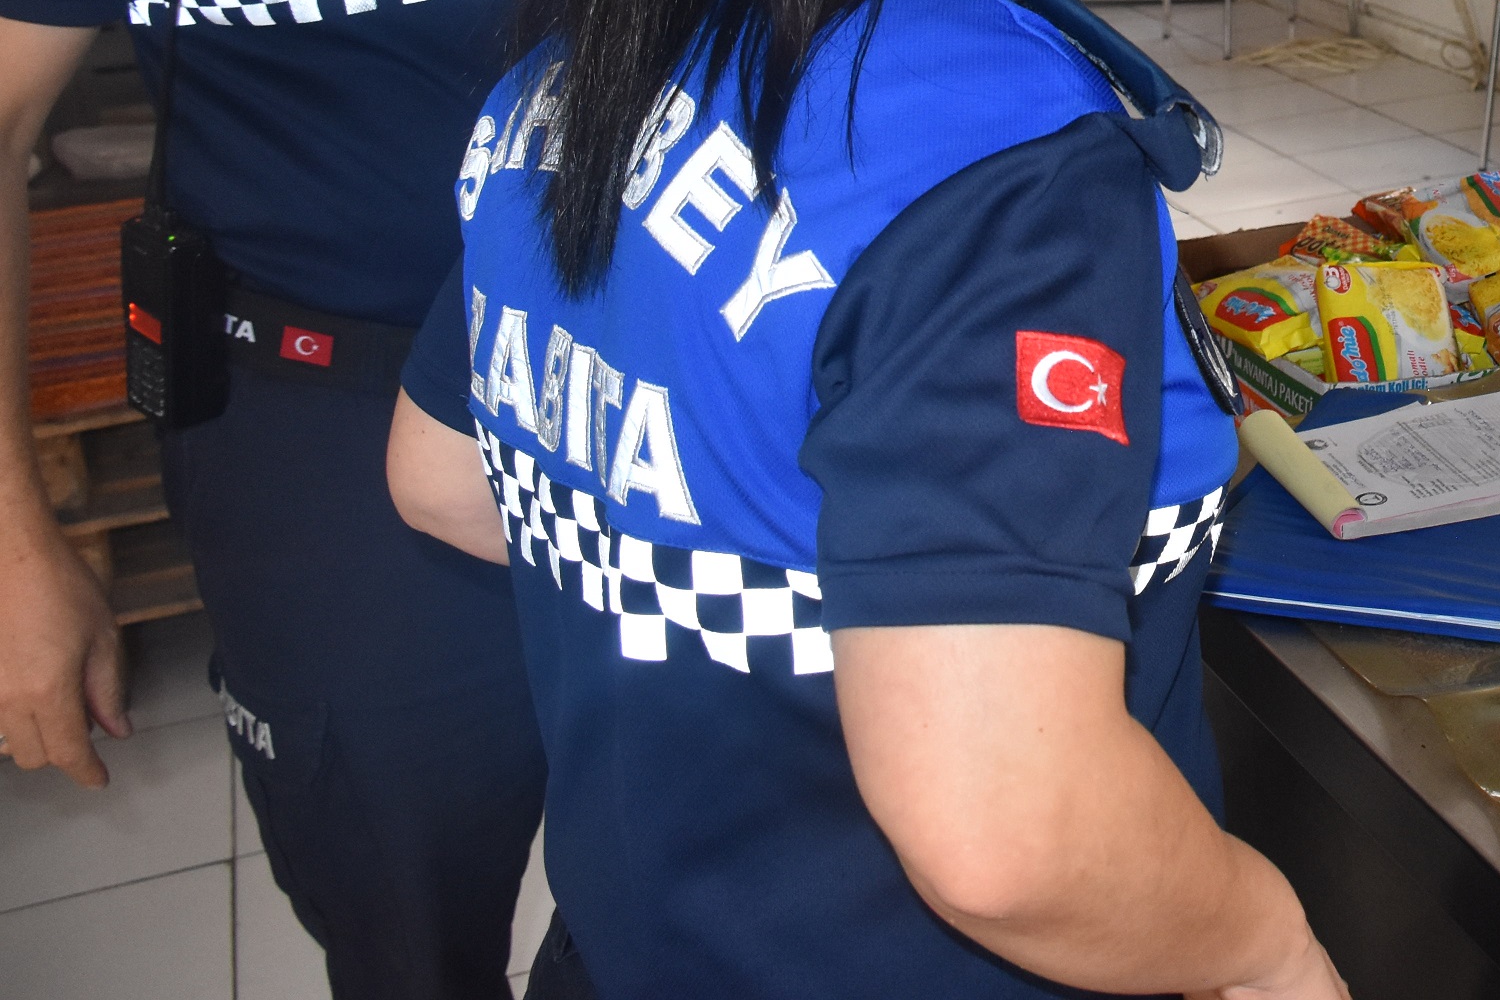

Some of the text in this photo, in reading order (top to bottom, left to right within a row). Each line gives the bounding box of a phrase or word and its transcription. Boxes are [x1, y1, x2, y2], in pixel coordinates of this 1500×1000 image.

[1337, 325, 1370, 382] domie
[1243, 365, 1279, 397] AVANTAJ
[1279, 382, 1314, 414] PAKETİ
